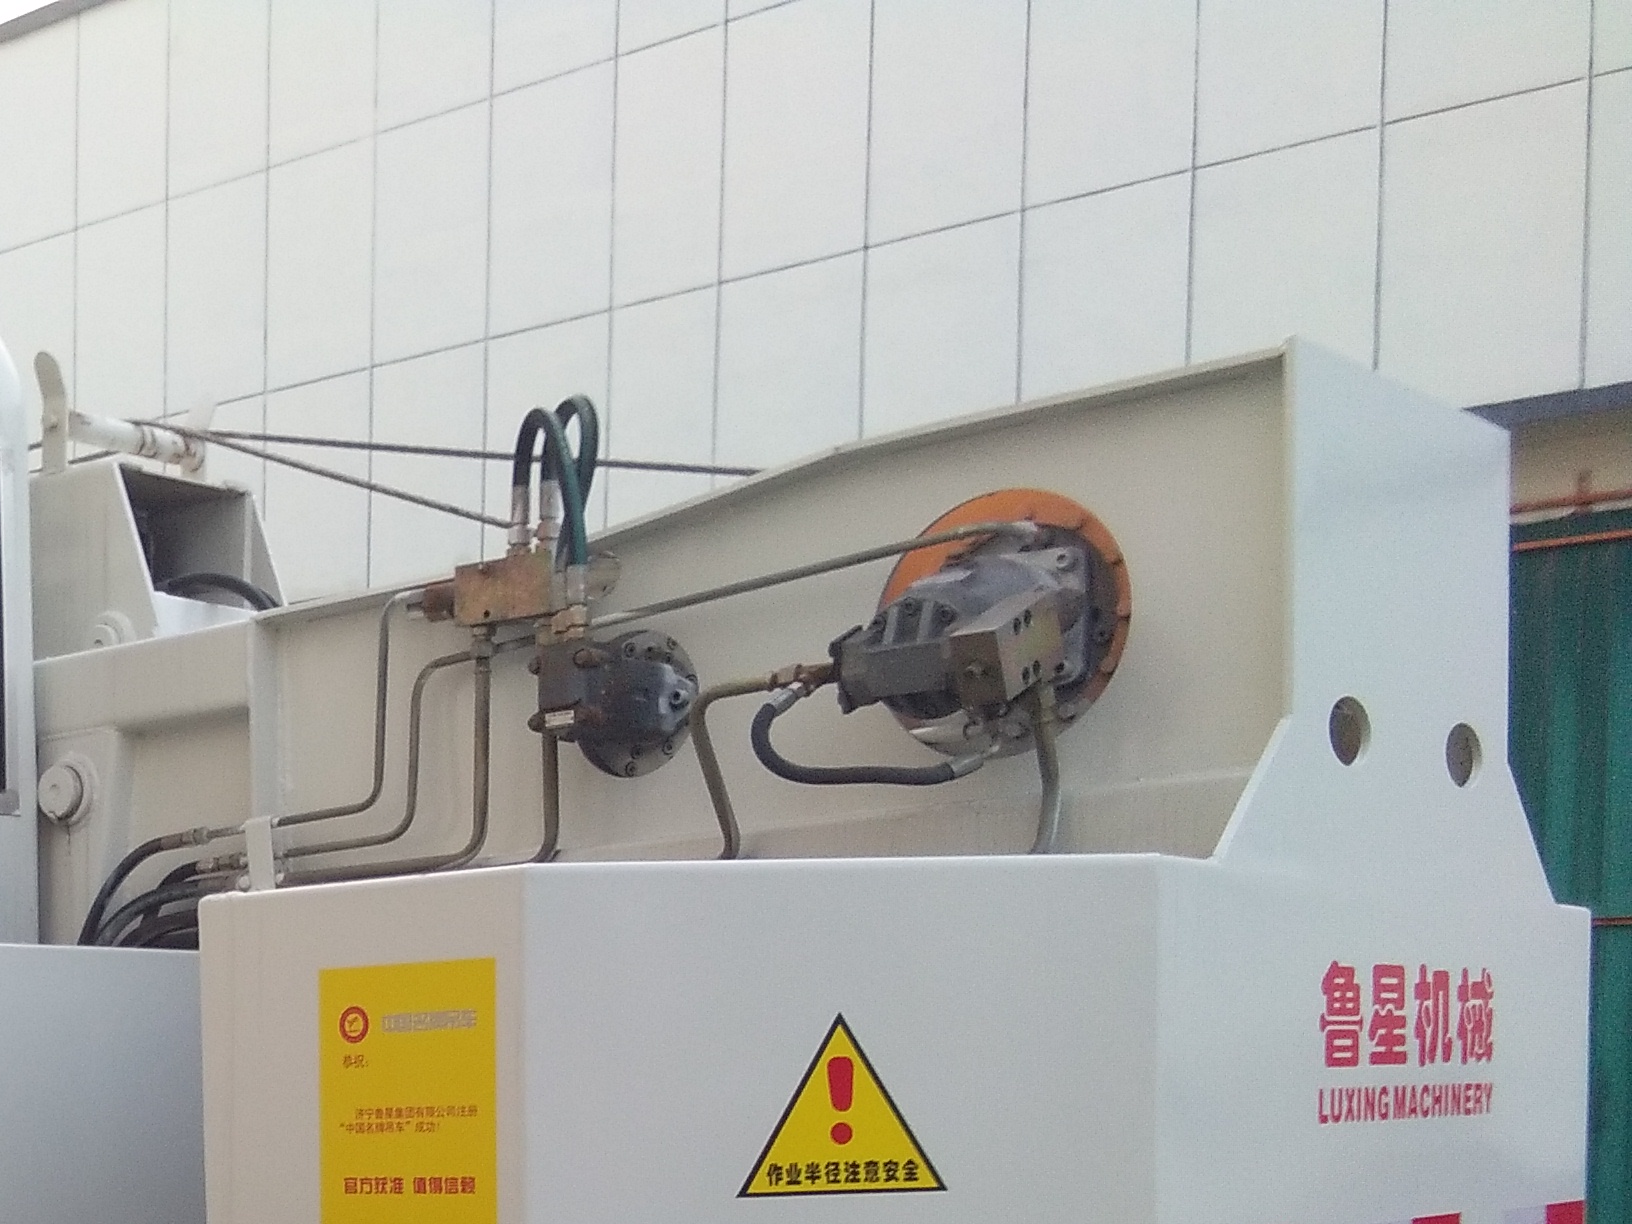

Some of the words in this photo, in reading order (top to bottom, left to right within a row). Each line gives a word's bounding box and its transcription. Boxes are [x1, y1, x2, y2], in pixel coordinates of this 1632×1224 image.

[1319, 960, 1494, 1068] 鲁星机械
[767, 1158, 920, 1187] 作业半径注意安全
